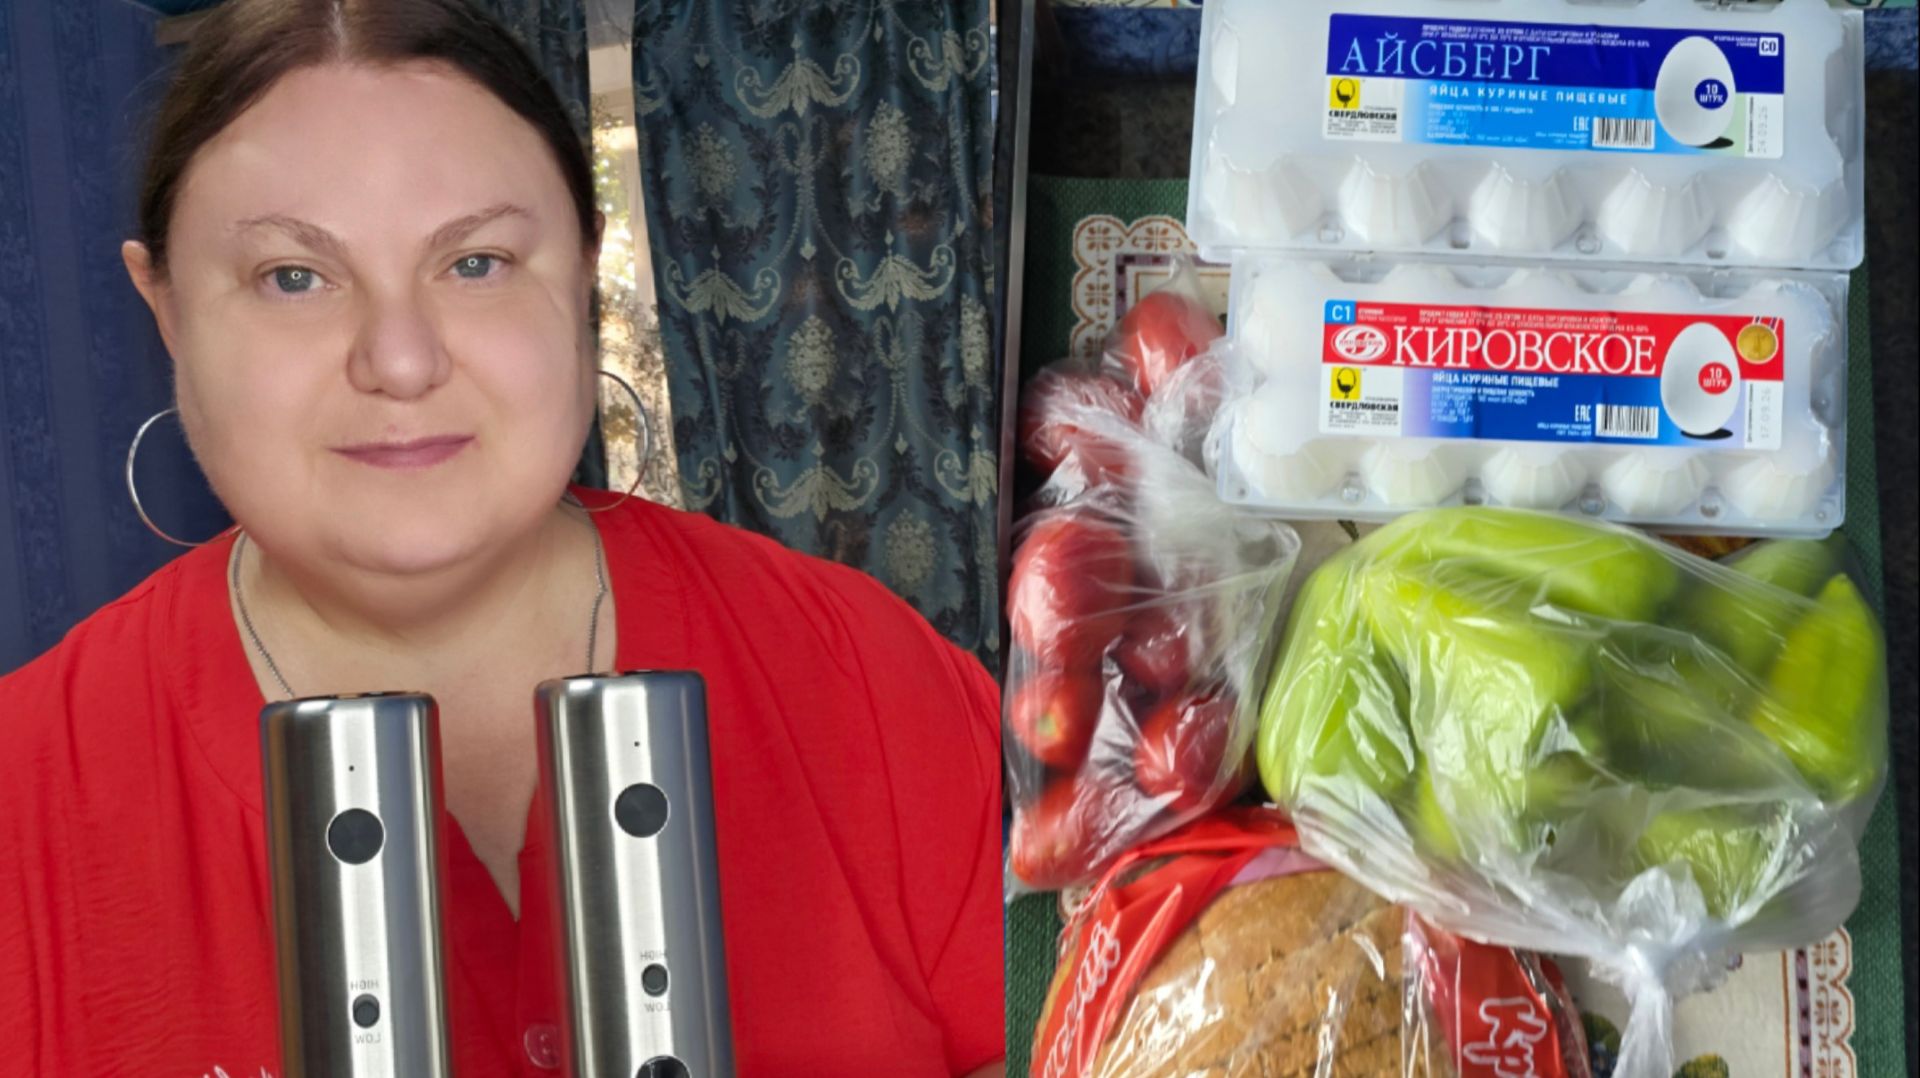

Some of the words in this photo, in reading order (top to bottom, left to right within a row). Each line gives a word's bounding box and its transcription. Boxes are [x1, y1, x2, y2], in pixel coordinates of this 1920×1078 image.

[1340, 32, 1550, 80] АЙСБЕРГ
[1429, 85, 1469, 98] ЯЙЦА
[1477, 87, 1548, 101] КУРИНЫЕ
[1556, 92, 1627, 105] ПИЩЕВЫЕ
[1706, 84, 1718, 94] 10
[1700, 95, 1723, 103] ШТУК
[1392, 325, 1656, 375] КИРОВСКОЕ
[1709, 368, 1722, 378] 10
[1432, 372, 1461, 384] ЯЙЦА
[1462, 373, 1509, 386] КУРИНЫЕ
[1511, 376, 1560, 388] ПИЩЕВЫЕ
[1703, 378, 1727, 388] ШТУК
